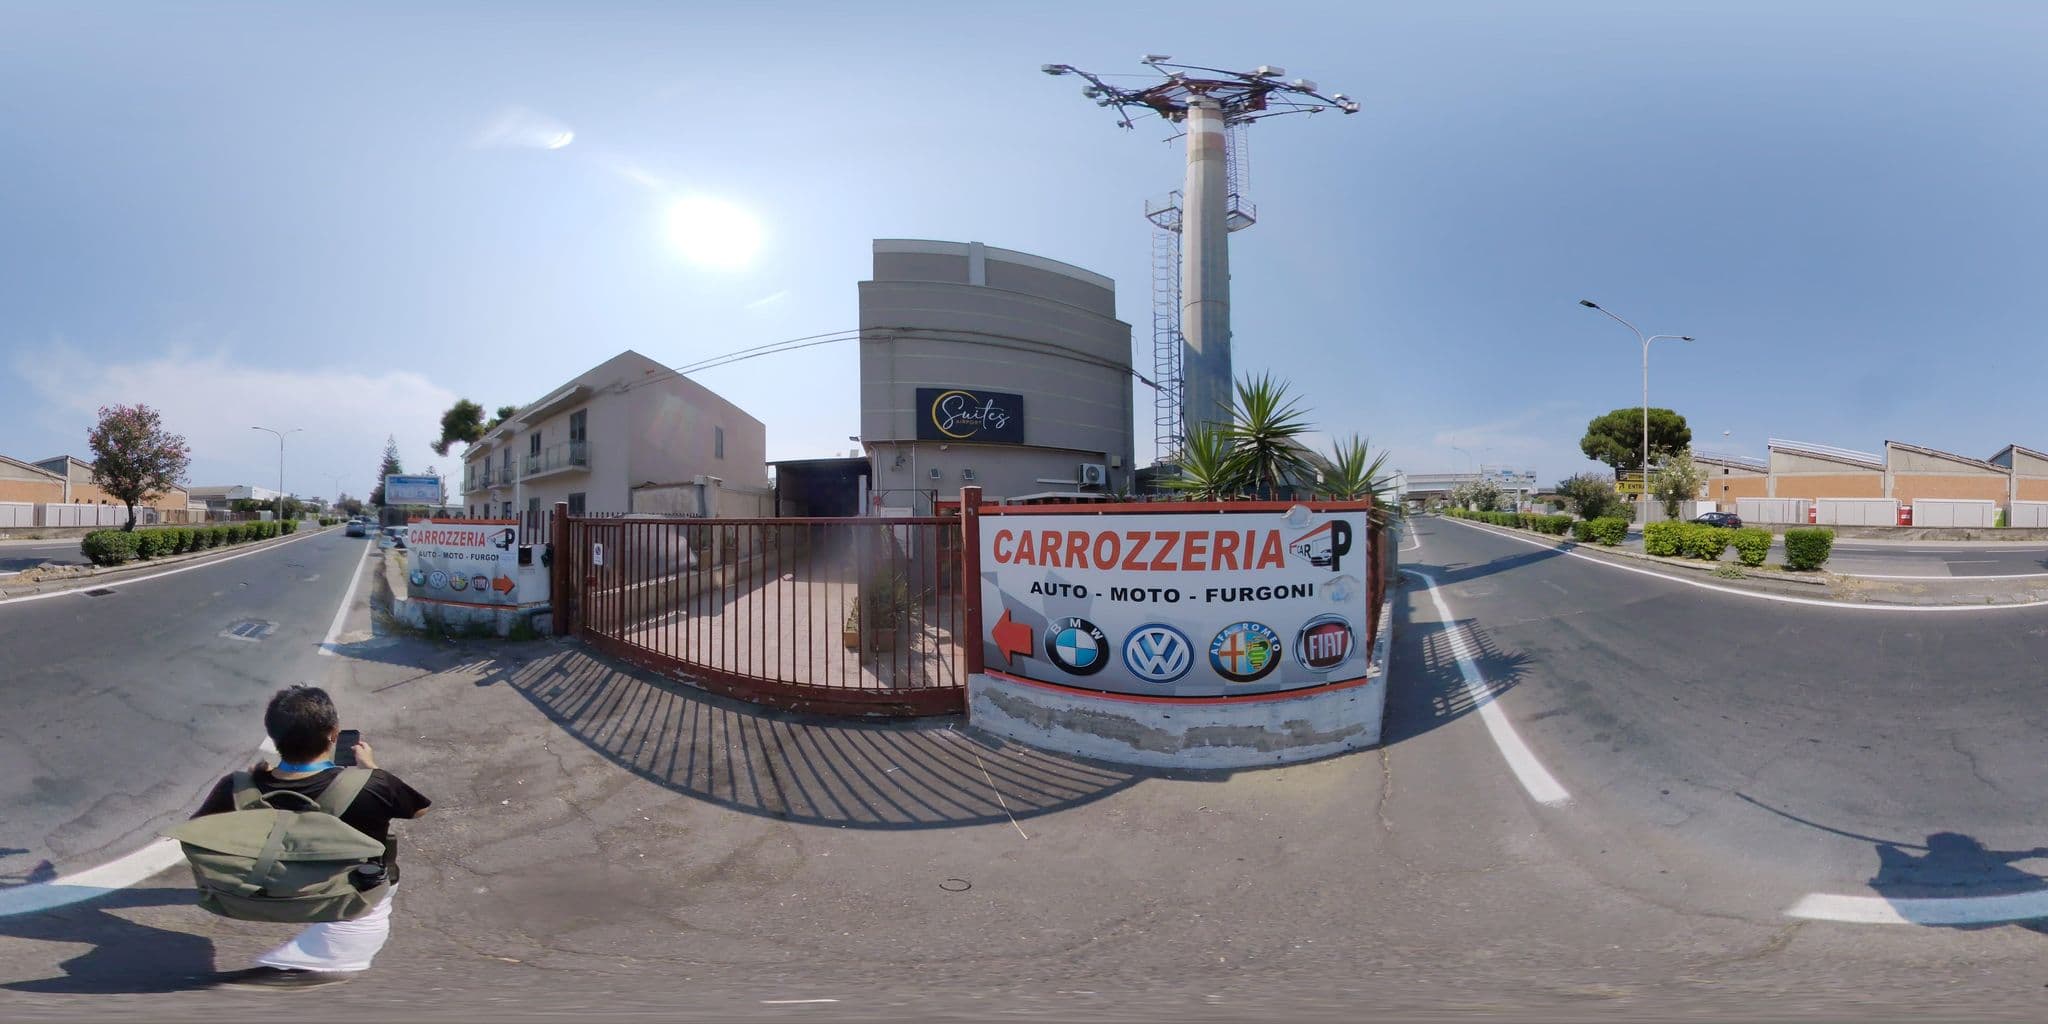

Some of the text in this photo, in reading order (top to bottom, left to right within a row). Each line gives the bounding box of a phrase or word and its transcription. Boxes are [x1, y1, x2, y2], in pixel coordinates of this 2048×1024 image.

[942, 395, 1010, 430] Suites
[411, 530, 486, 547] CARROZZERIA
[993, 529, 1285, 571] CARROZZERIA
[1297, 544, 1311, 559] CAR
[1030, 581, 1088, 598] AUTO
[1110, 588, 1181, 603] MOTO
[1205, 583, 1314, 603] FURGONI
[1050, 618, 1103, 641] BMW
[1210, 623, 1281, 656] ALFA ROMEO
[1309, 631, 1345, 661] FIAT
